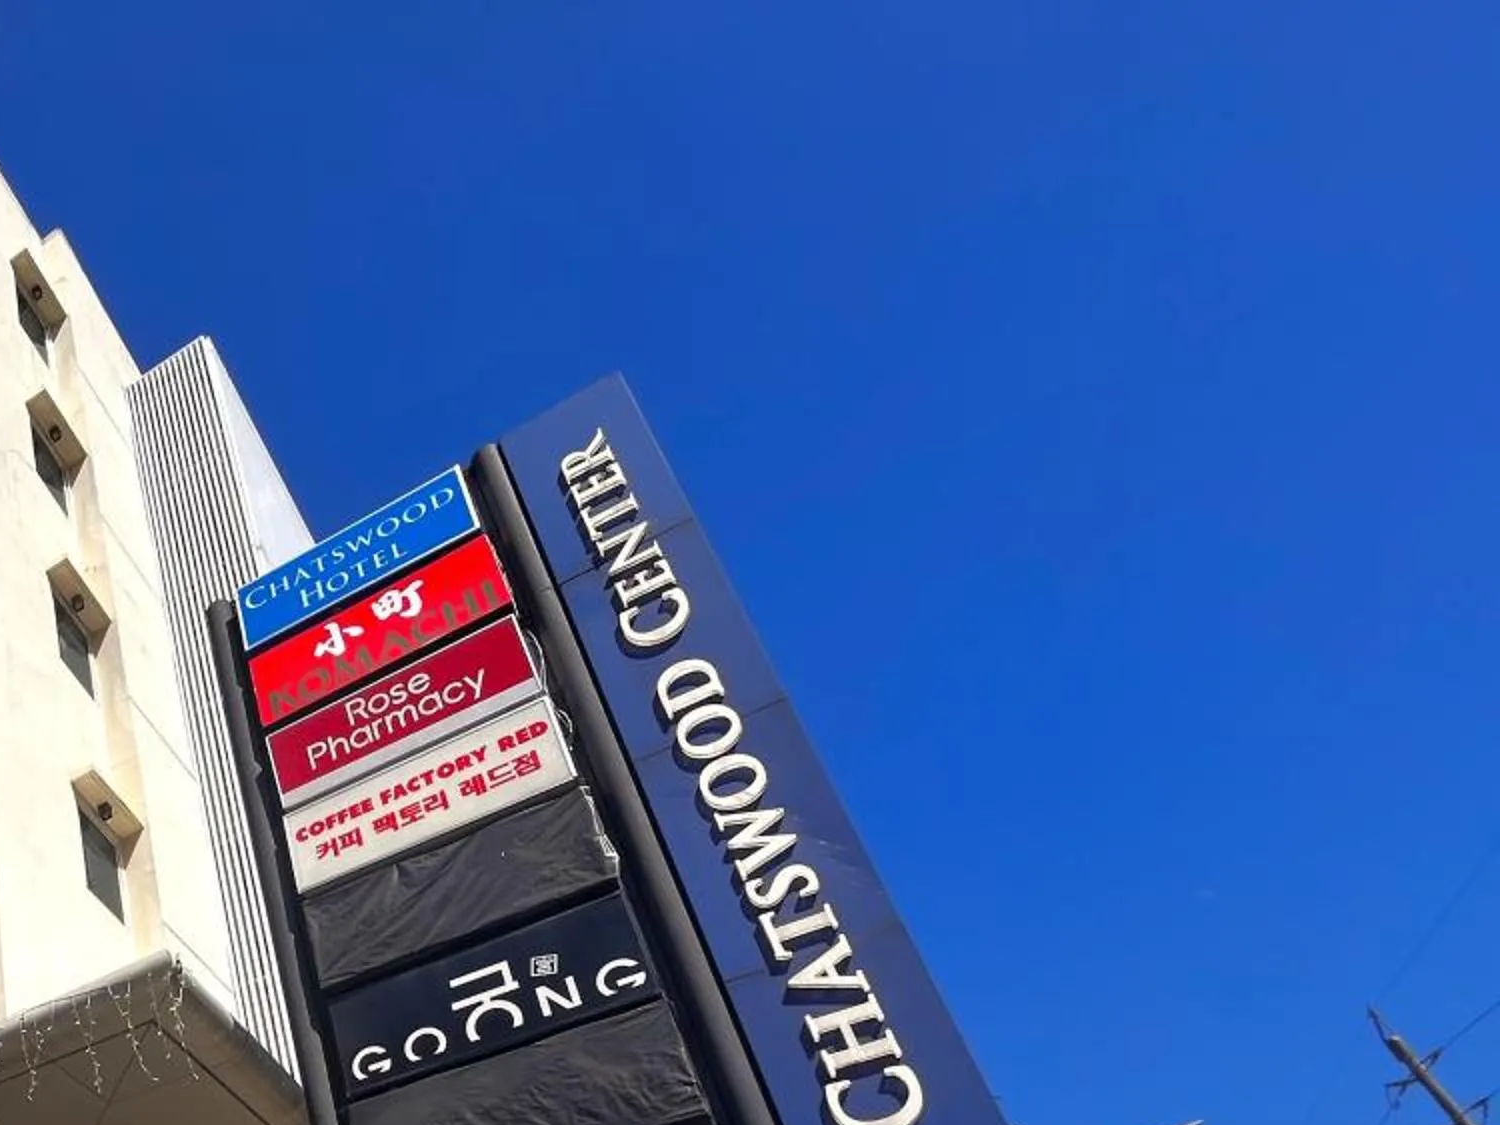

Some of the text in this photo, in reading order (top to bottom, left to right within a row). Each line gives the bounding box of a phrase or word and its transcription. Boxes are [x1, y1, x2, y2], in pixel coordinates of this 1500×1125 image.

[244, 487, 454, 610] CHATSWOOD
[300, 544, 407, 608] HOTEL
[561, 428, 691, 649] CENTER
[268, 579, 499, 718] KOMACHI
[345, 671, 431, 726] Rose
[307, 668, 485, 771] Pharmacy
[295, 720, 549, 843] COFFEE FACTORY RED
[316, 828, 364, 860] 커피
[371, 790, 450, 834] 팩토리
